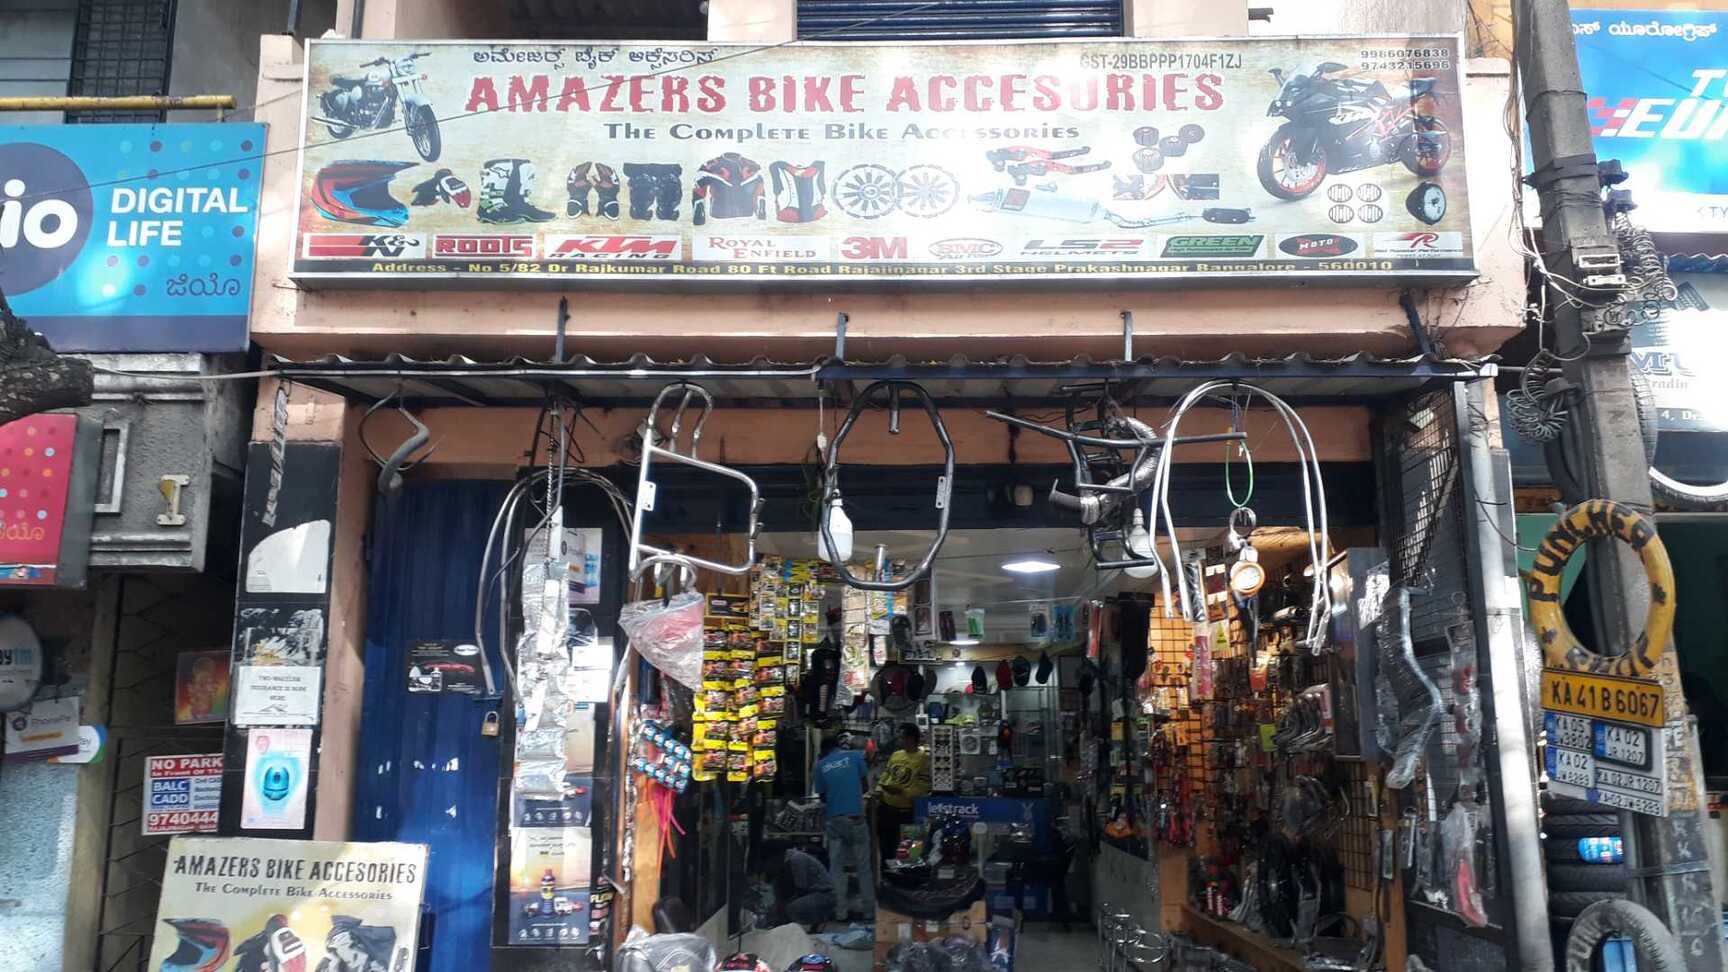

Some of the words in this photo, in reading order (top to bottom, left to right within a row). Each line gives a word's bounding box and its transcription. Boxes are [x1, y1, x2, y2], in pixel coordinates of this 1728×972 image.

[1691, 69, 1728, 97] T
[465, 73, 726, 113] AMAZERS
[749, 74, 865, 113] BIKE
[603, 123, 656, 139] The
[669, 123, 809, 143] Complete
[825, 123, 888, 140] Bike
[901, 123, 1080, 140] Accssories
[111, 188, 248, 213] DIGITAL
[107, 220, 183, 246] LIFE
[1169, 236, 1258, 247] GREEN
[435, 236, 533, 257] ROOTS
[555, 236, 678, 253] KTM
[709, 237, 775, 248] ROYAL
[841, 236, 908, 259] 3M
[1022, 239, 1144, 249] LS2
[733, 248, 816, 258] ENFIELD
[372, 263, 447, 273] Address
[469, 263, 492, 273] No
[500, 263, 541, 274] 5/82
[575, 263, 664, 275] Rajkumar
[673, 263, 720, 274] Road
[728, 264, 751, 274] 80
[758, 264, 777, 274] Ft
[784, 264, 832, 275] Road
[955, 264, 986, 274] 3rd
[992, 264, 1049, 275] Stage
[1318, 261, 1393, 271] 560010
[151, 760, 176, 770] NO
[153, 781, 188, 792] BALC
[152, 793, 188, 805] CADD
[174, 855, 262, 879] AMAZERS
[266, 857, 304, 880] BIKE
[308, 860, 417, 884] ACCESORIES
[195, 882, 217, 894] The
[222, 884, 281, 897] Complete
[286, 886, 313, 898] Bike
[318, 888, 393, 901] Accessories
